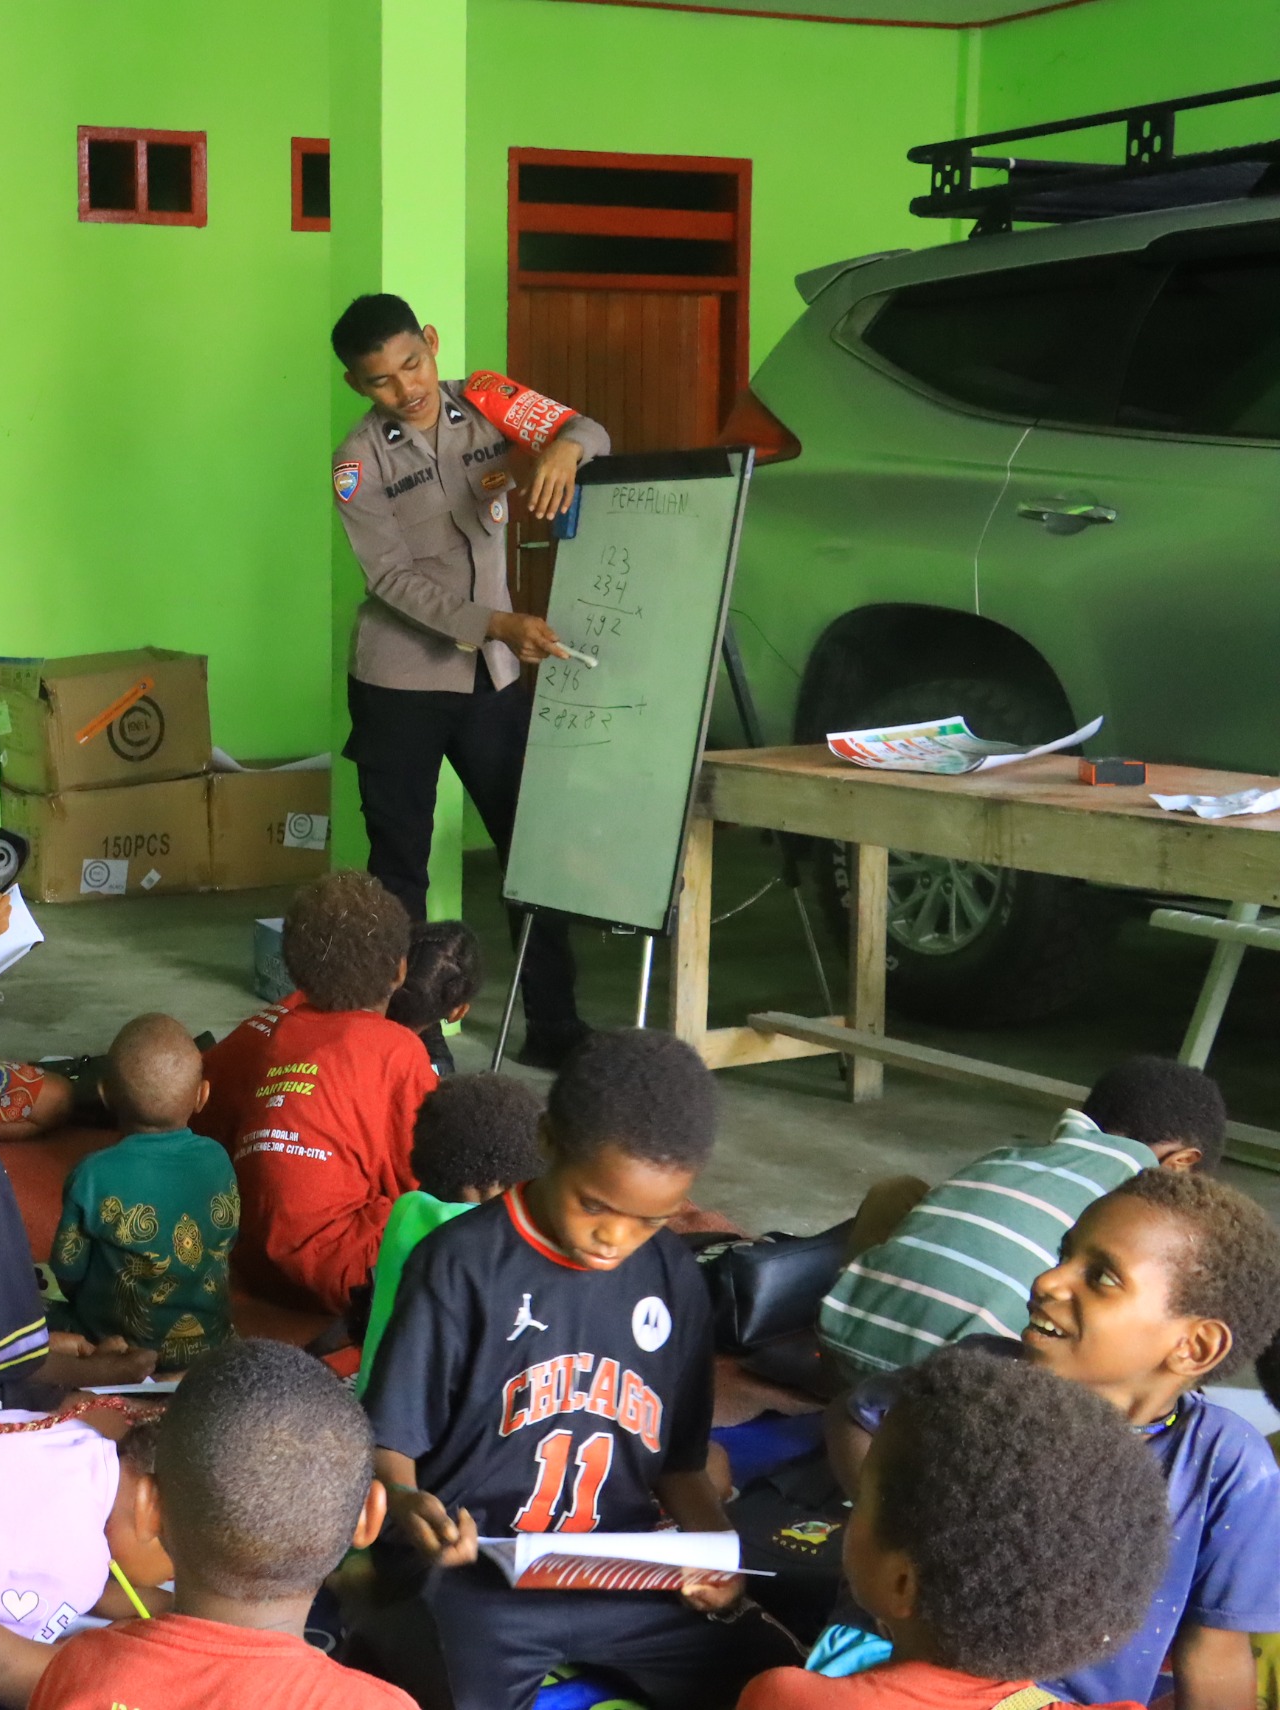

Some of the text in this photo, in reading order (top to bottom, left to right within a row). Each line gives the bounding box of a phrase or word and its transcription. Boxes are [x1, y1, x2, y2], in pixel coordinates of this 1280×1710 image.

[520, 398, 558, 441] PETUG
[531, 403, 573, 452] PENGA
[610, 486, 689, 514] PERKALIAN
[600, 545, 631, 575] 123
[593, 574, 627, 604] 234
[585, 613, 622, 637] 492
[545, 665, 580, 693] 246
[102, 833, 171, 858] 150PCS
[266, 1063, 319, 1078] RASAKA
[271, 1129, 299, 1142] ADALAH
[499, 1352, 665, 1454] CHICAGO
[510, 1428, 615, 1533] 11
